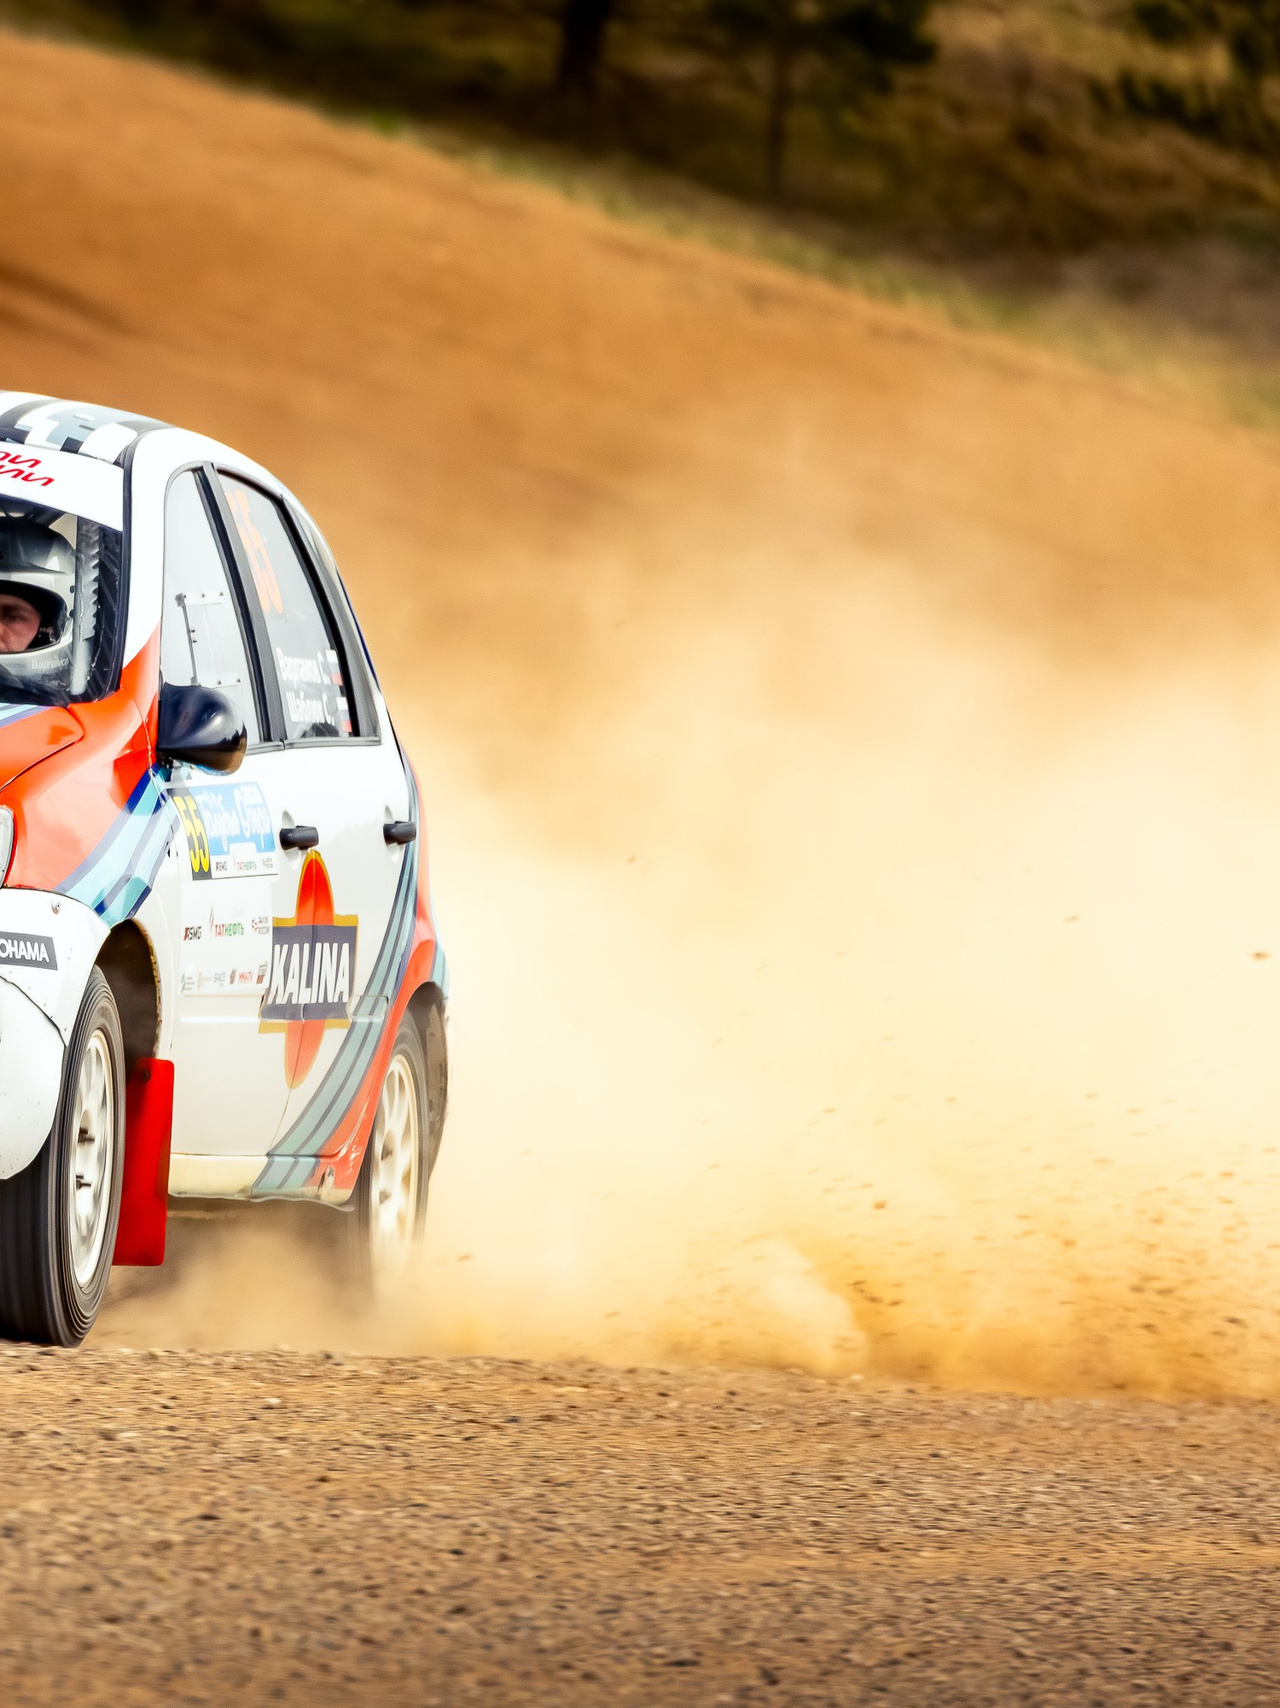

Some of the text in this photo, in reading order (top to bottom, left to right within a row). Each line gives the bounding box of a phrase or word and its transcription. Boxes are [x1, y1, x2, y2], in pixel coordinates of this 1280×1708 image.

[172, 796, 210, 873] 55
[215, 922, 245, 937] ТАТНЕФТЬ
[270, 942, 350, 1005] KALINA
